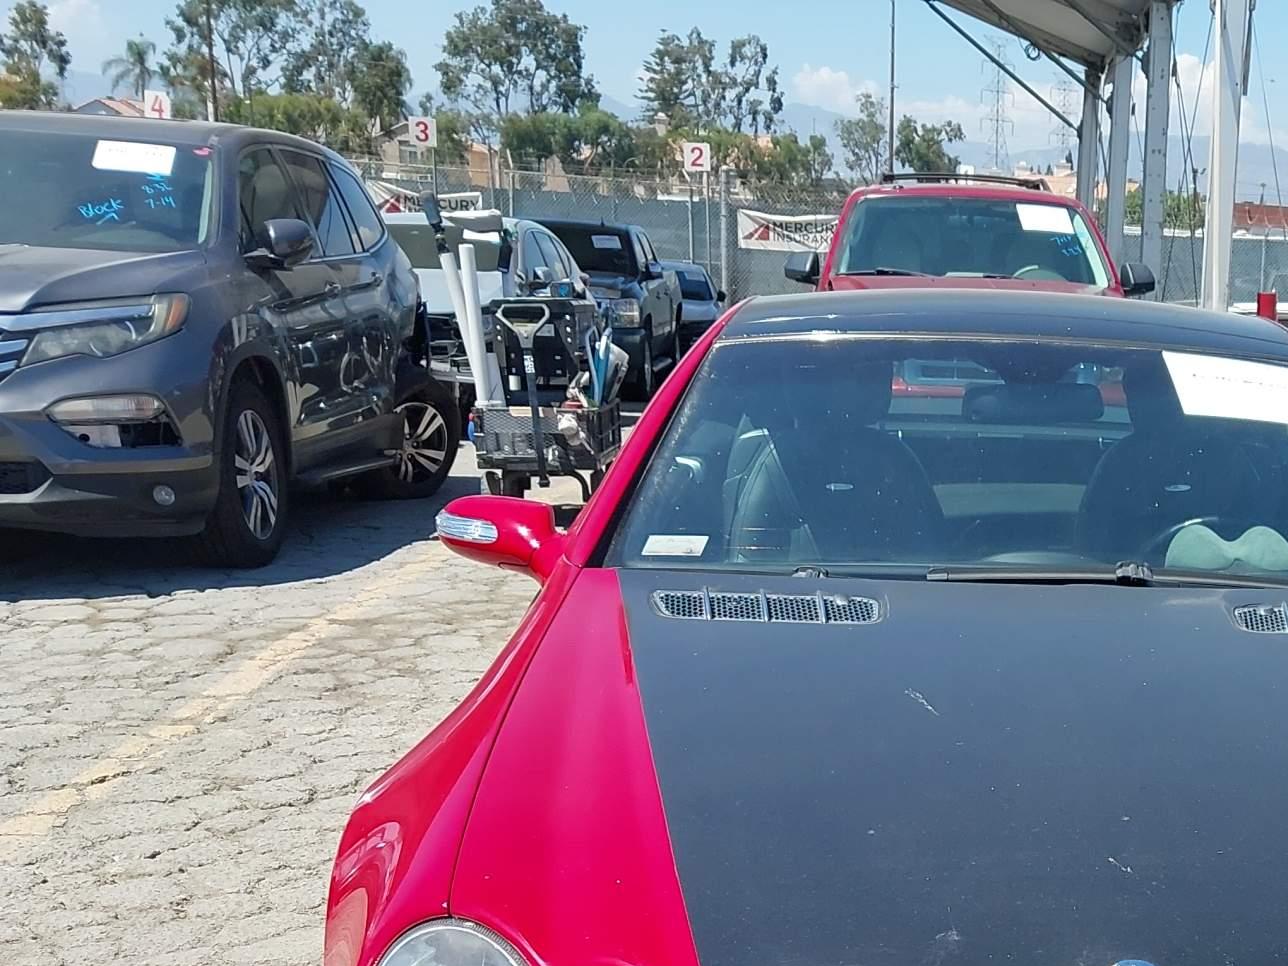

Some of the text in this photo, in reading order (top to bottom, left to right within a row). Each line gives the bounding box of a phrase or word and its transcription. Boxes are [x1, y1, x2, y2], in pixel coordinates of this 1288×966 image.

[151, 95, 164, 119] 4
[415, 121, 429, 142] 3
[691, 147, 704, 167] 2
[404, 194, 479, 210] MECURY
[773, 221, 838, 234] MERCUR
